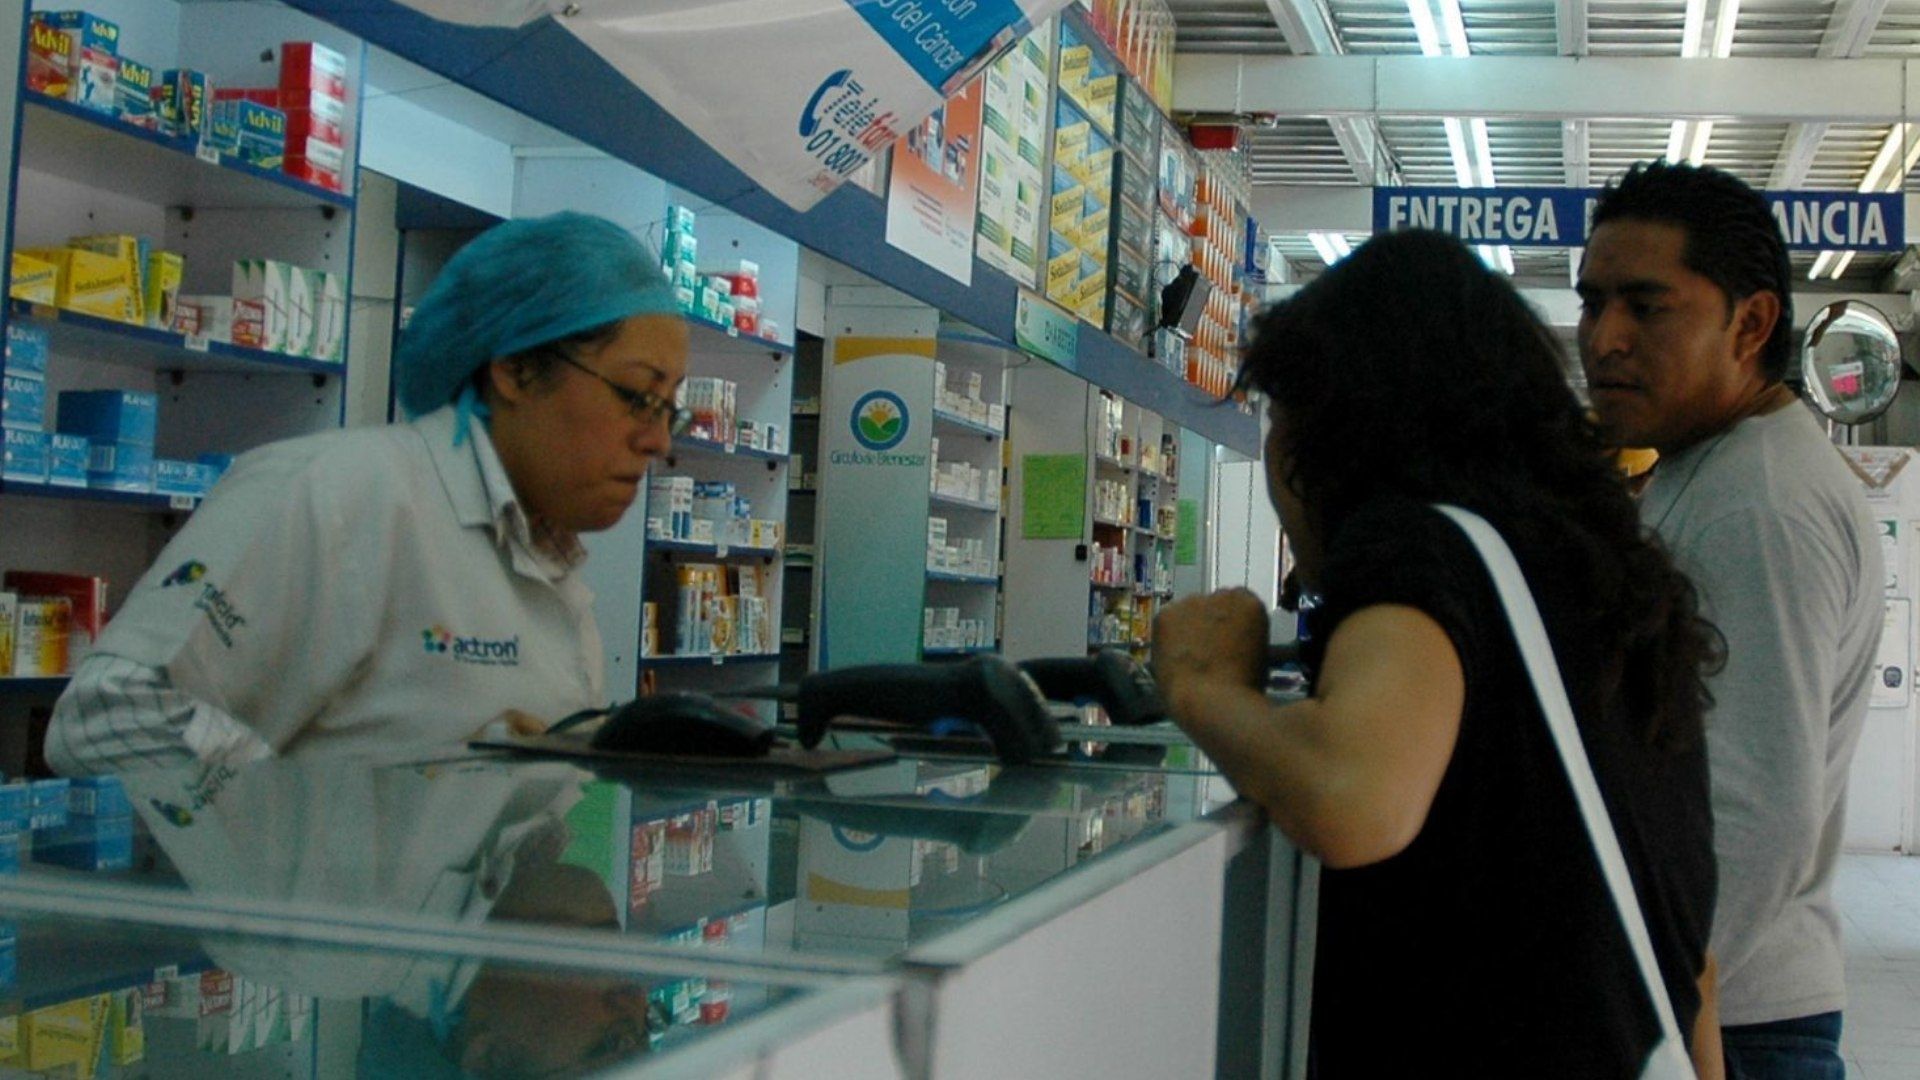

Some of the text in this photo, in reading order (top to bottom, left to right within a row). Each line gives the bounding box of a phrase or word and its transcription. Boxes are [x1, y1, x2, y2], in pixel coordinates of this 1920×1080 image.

[32, 23, 70, 57] Advil
[892, 1, 965, 70] del Cáncer
[121, 60, 151, 88] Advil
[247, 108, 283, 133] Advil
[806, 129, 841, 158] 01
[1388, 196, 1559, 241] ENTREGA
[1771, 200, 1888, 246] ANCIA
[453, 636, 517, 659] actron
